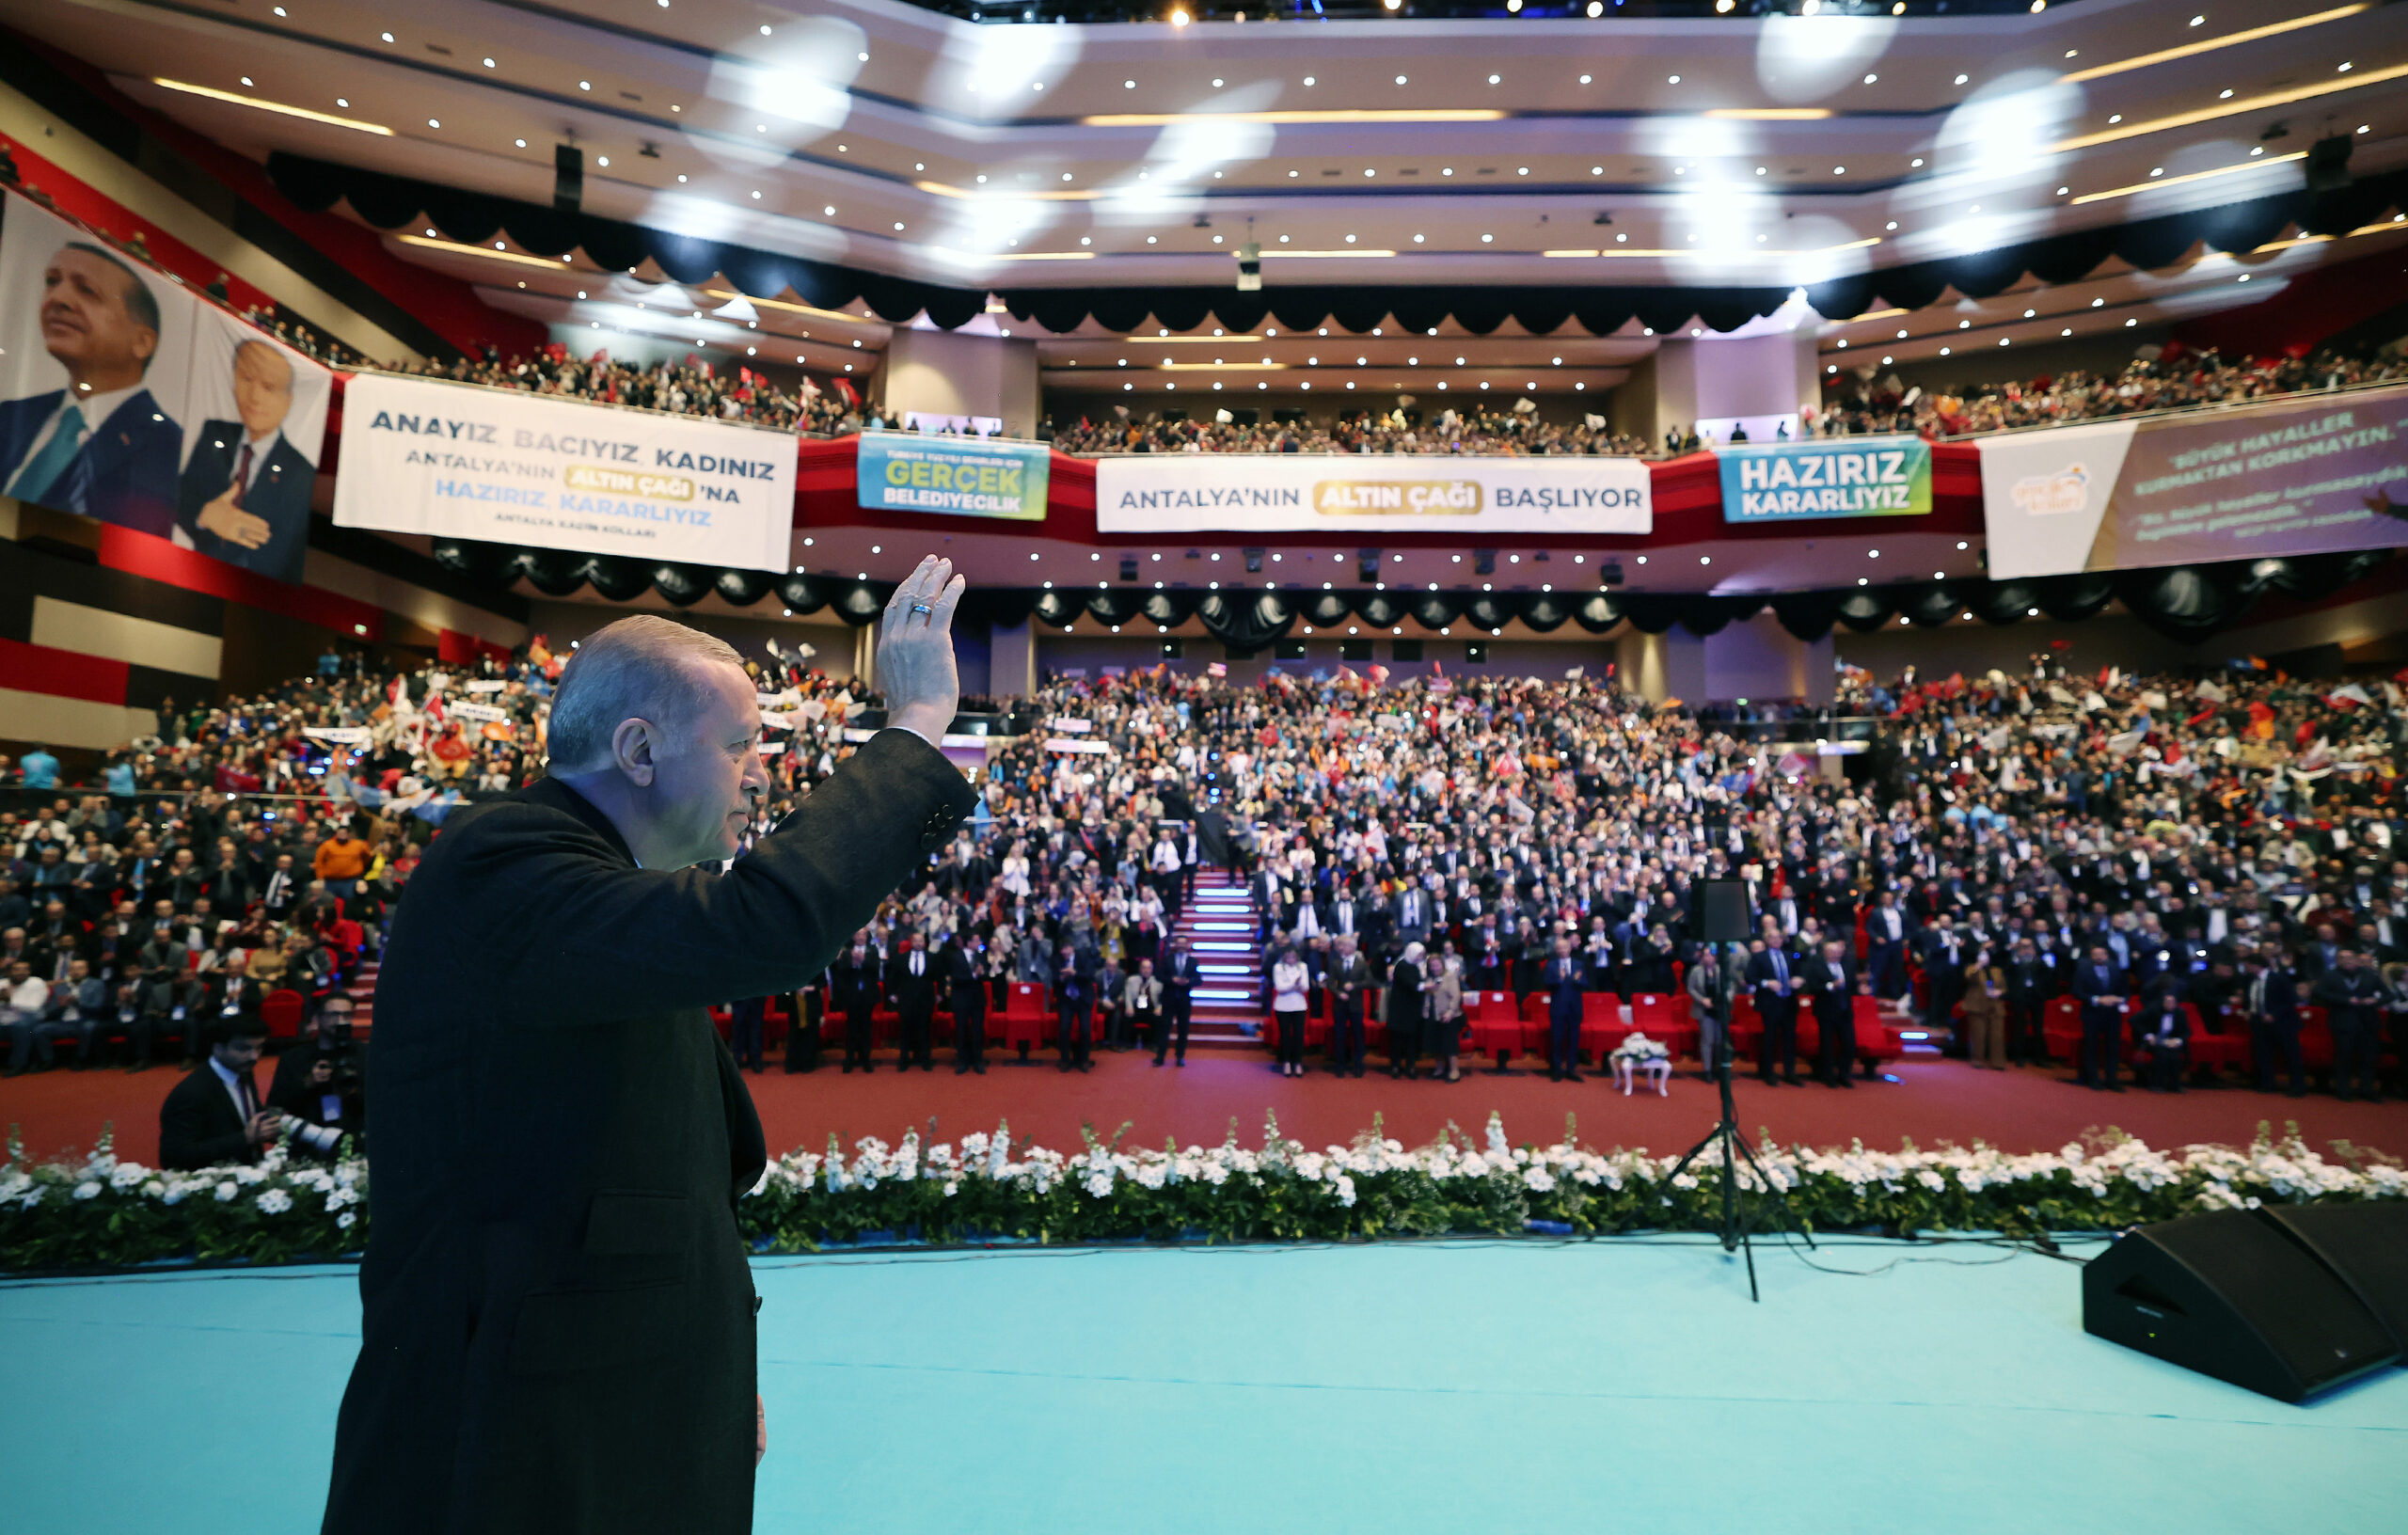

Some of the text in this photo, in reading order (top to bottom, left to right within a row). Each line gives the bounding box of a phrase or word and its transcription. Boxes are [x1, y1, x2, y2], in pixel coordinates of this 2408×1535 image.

[569, 469, 634, 491] ALTIN
[656, 448, 775, 481] KADINIZ
[886, 460, 1022, 493] GERÇEK
[1740, 451, 1908, 490] HAZIRIZ
[560, 494, 712, 526] KARARLIYIZ
[1119, 482, 1642, 514] ANTALYA'NIN ALTIN ÇAĞI BAŞLIYOR
[1741, 484, 1910, 515] KARARLIYIZ
